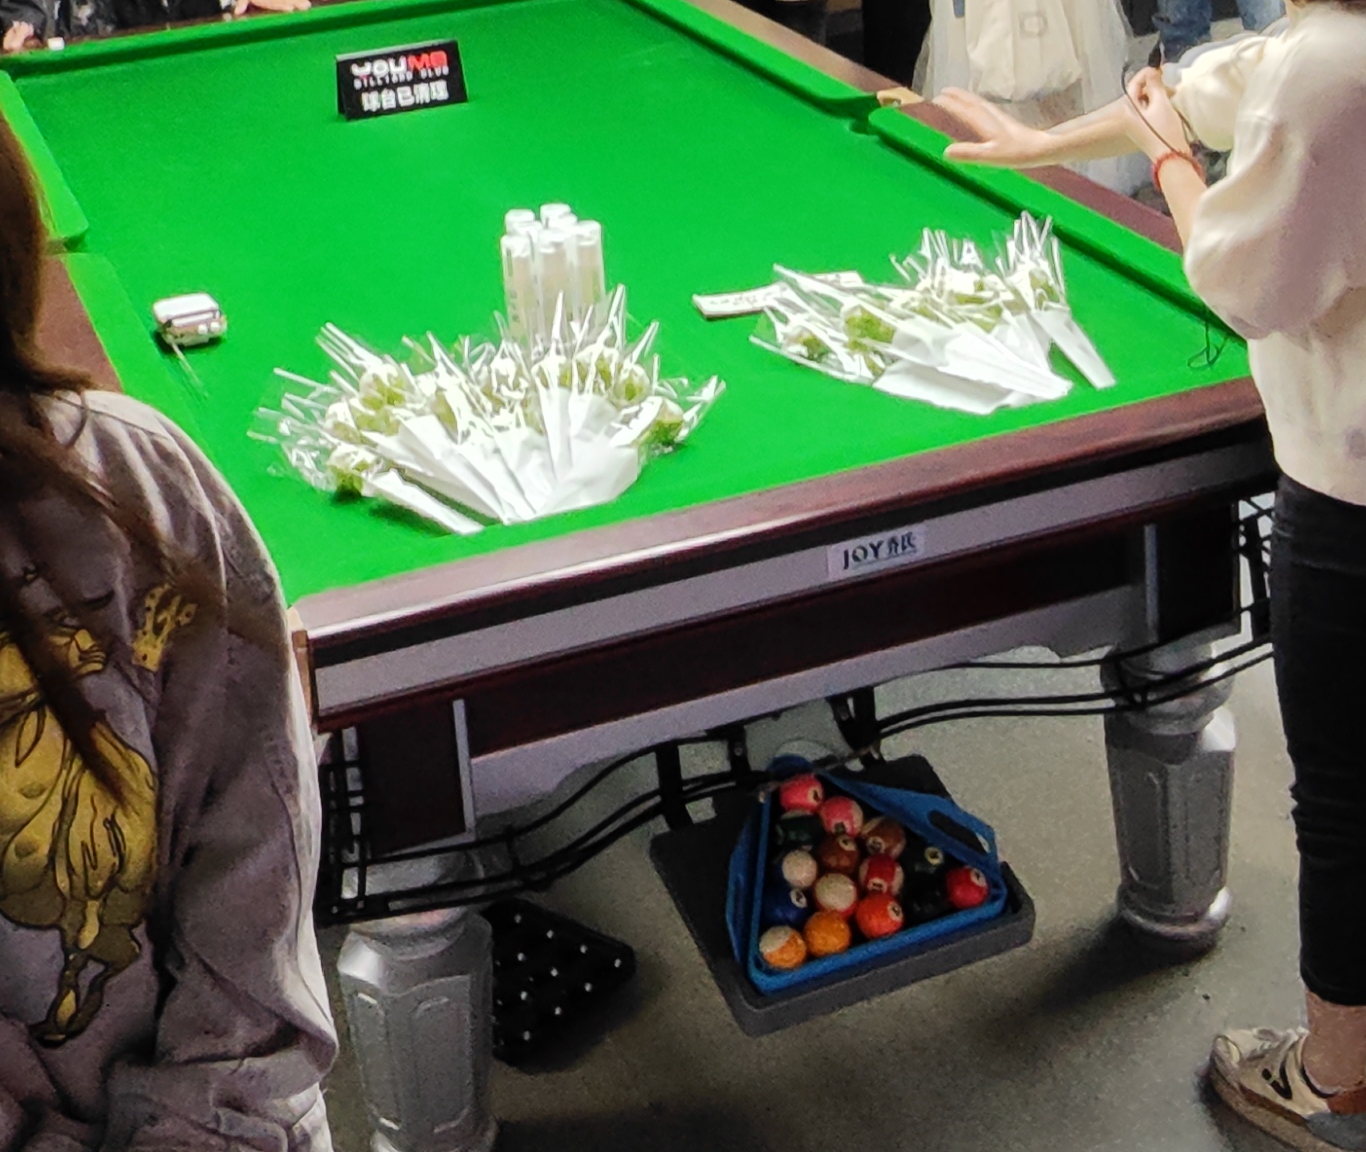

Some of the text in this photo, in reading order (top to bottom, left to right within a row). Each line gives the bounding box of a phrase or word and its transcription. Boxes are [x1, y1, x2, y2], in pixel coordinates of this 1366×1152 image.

[353, 65, 449, 90] BILLIARD CLUB
[843, 540, 884, 570] JOY
